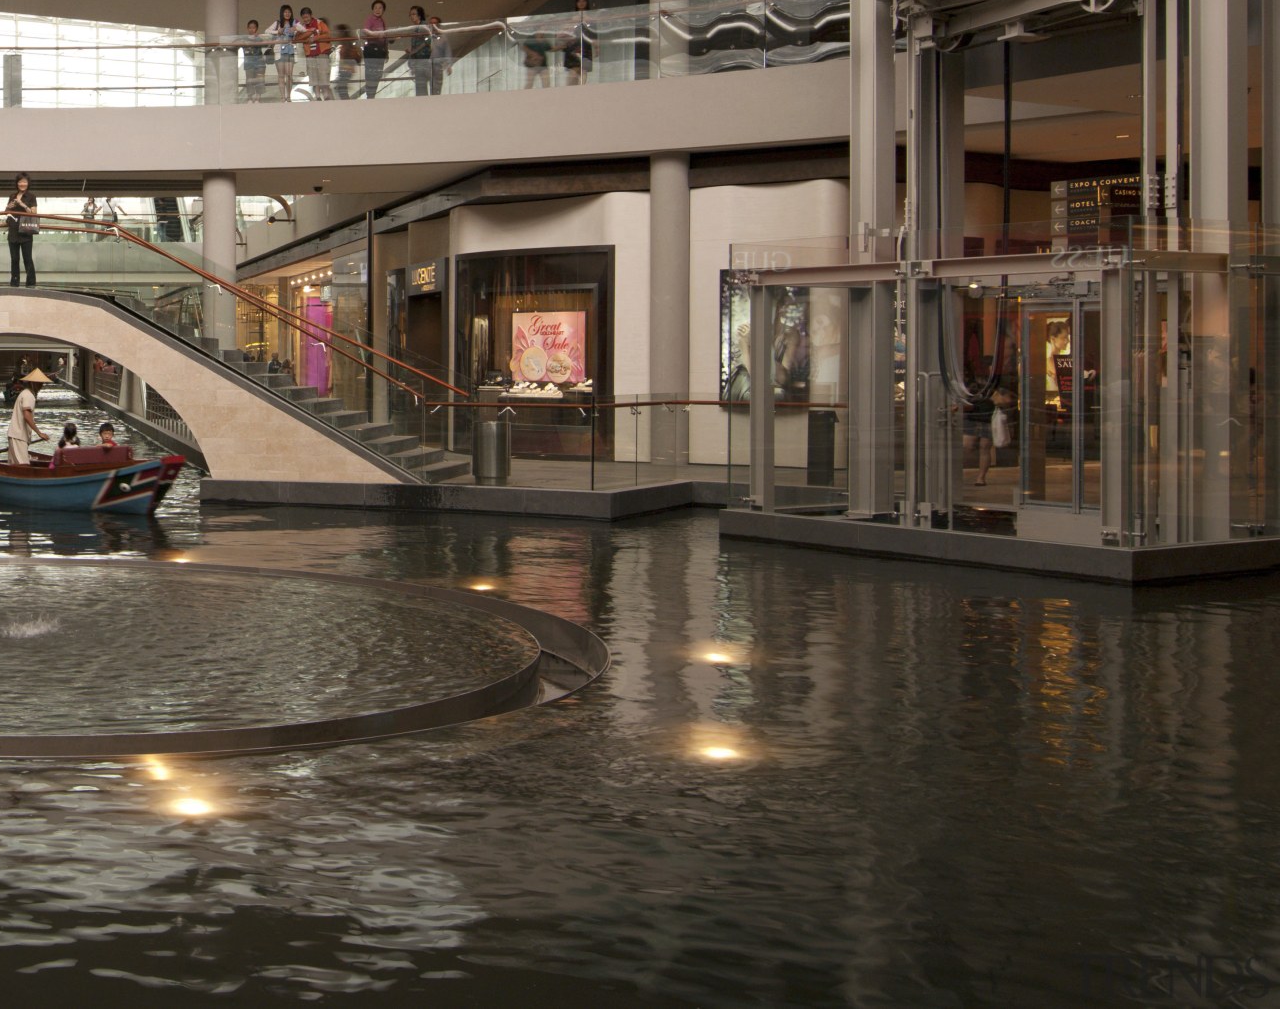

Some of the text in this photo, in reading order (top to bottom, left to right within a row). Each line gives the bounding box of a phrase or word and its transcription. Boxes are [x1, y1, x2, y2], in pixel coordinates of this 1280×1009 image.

[1070, 180, 1090, 189] EXPO
[1099, 176, 1141, 186] CONVENT
[1070, 200, 1095, 208] HOTEL
[528, 315, 562, 336] Great
[543, 337, 569, 351] Sale
